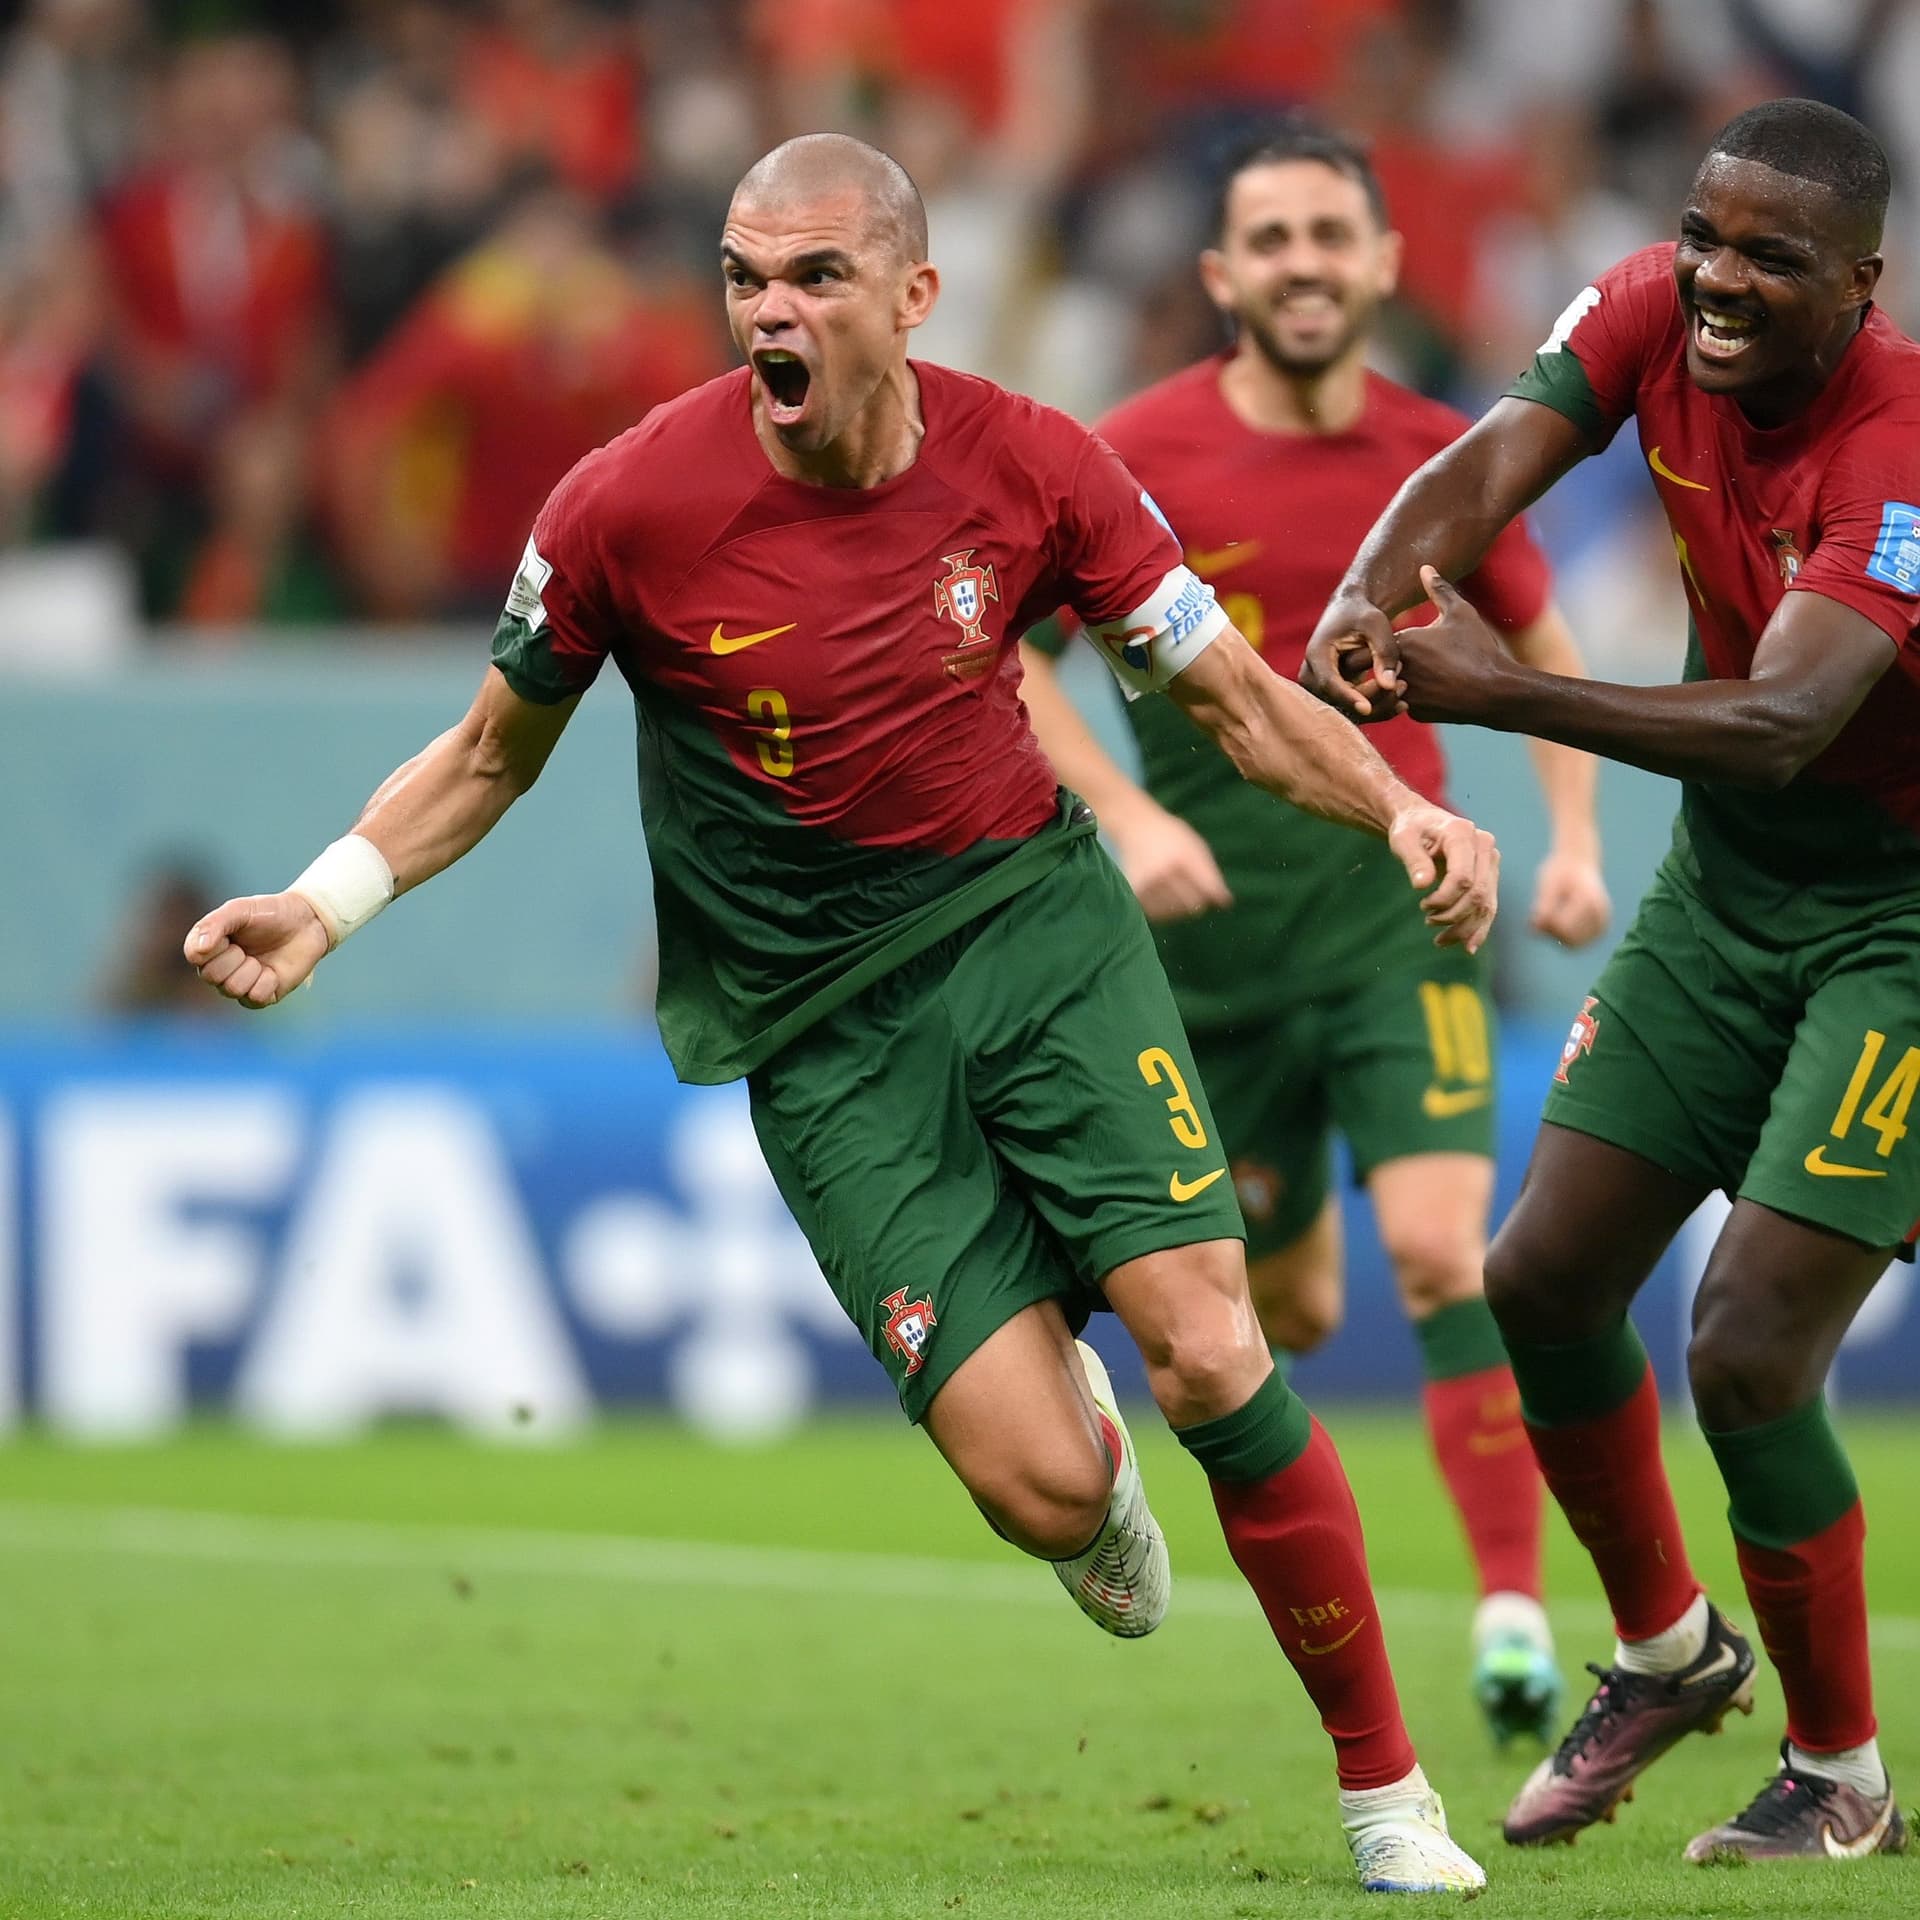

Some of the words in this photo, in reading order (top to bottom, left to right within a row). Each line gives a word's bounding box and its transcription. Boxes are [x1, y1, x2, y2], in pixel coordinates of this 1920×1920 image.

[747, 689, 794, 778] 3
[1418, 979, 1490, 1082] 10
[1137, 1046, 1209, 1149] 3
[1829, 1029, 1920, 1158] 14
[0, 1081, 592, 1446] FA
